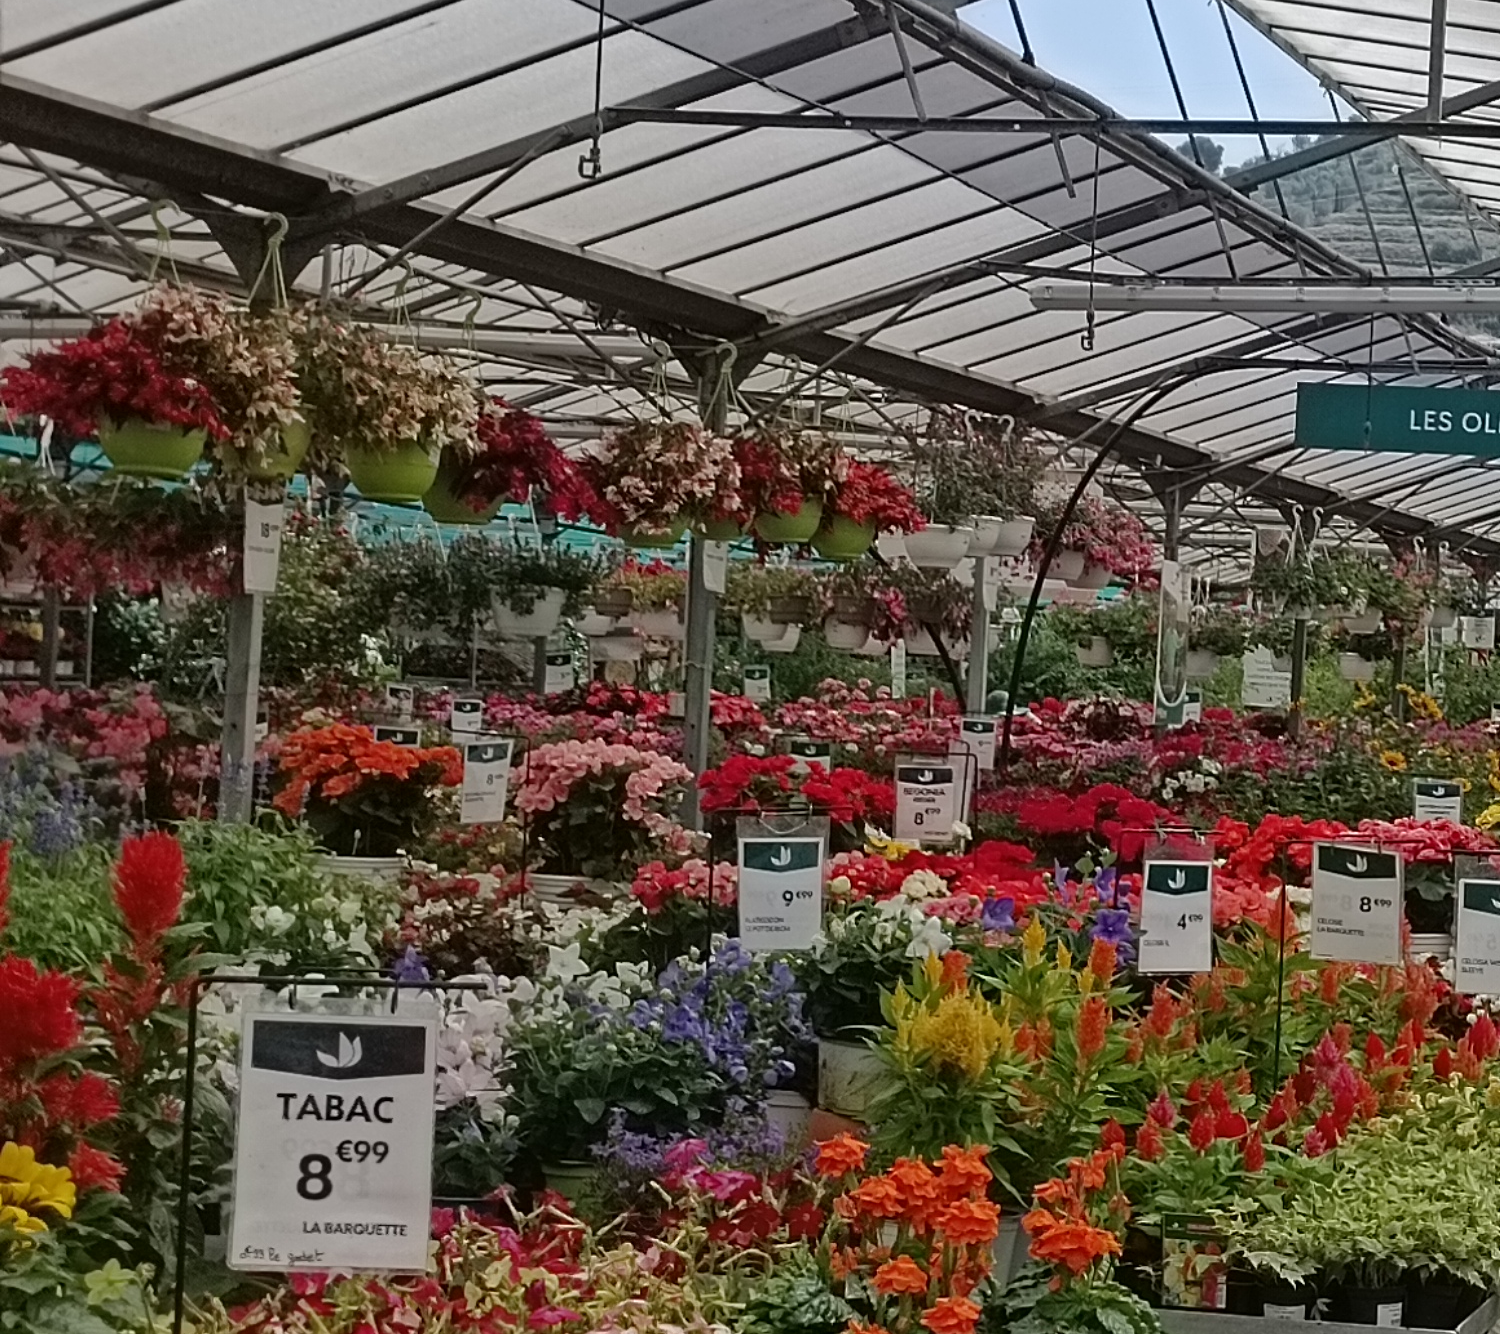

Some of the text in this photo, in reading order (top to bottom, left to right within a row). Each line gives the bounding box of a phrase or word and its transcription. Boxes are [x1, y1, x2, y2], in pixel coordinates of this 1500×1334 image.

[1410, 409, 1452, 432] LES
[914, 812, 924, 825] 8
[782, 889, 794, 907] 9
[1359, 895, 1372, 912] 8
[1177, 913, 1186, 930] 4
[276, 1092, 394, 1124] TABAC
[296, 1139, 389, 1200] 8 €99
[303, 1221, 408, 1237] LA BARQUETTE
